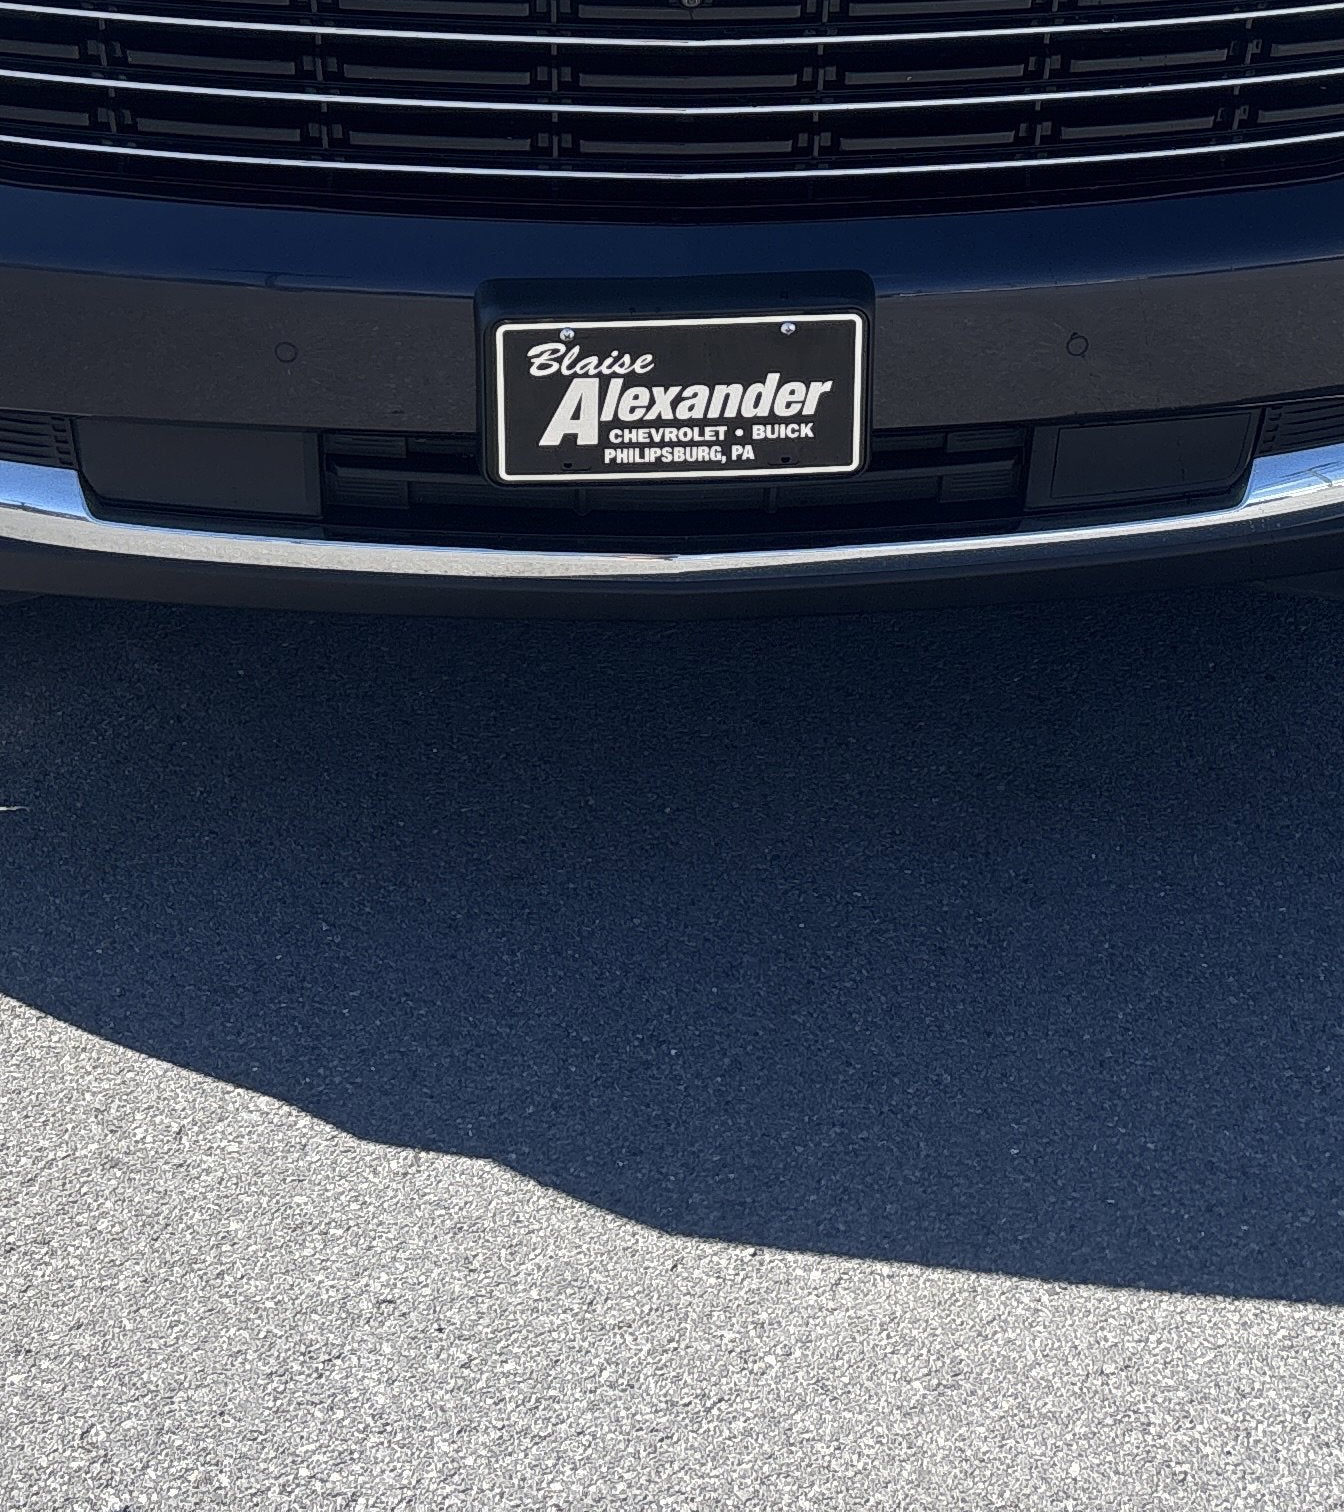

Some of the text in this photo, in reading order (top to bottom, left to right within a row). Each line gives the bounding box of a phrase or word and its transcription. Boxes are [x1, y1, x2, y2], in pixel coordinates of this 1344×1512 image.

[527, 342, 655, 377] Blaise
[538, 372, 834, 446] Alexander
[608, 422, 815, 444] CHEVROLET BUICK
[604, 444, 755, 465] PHILIPSBURG, PA
